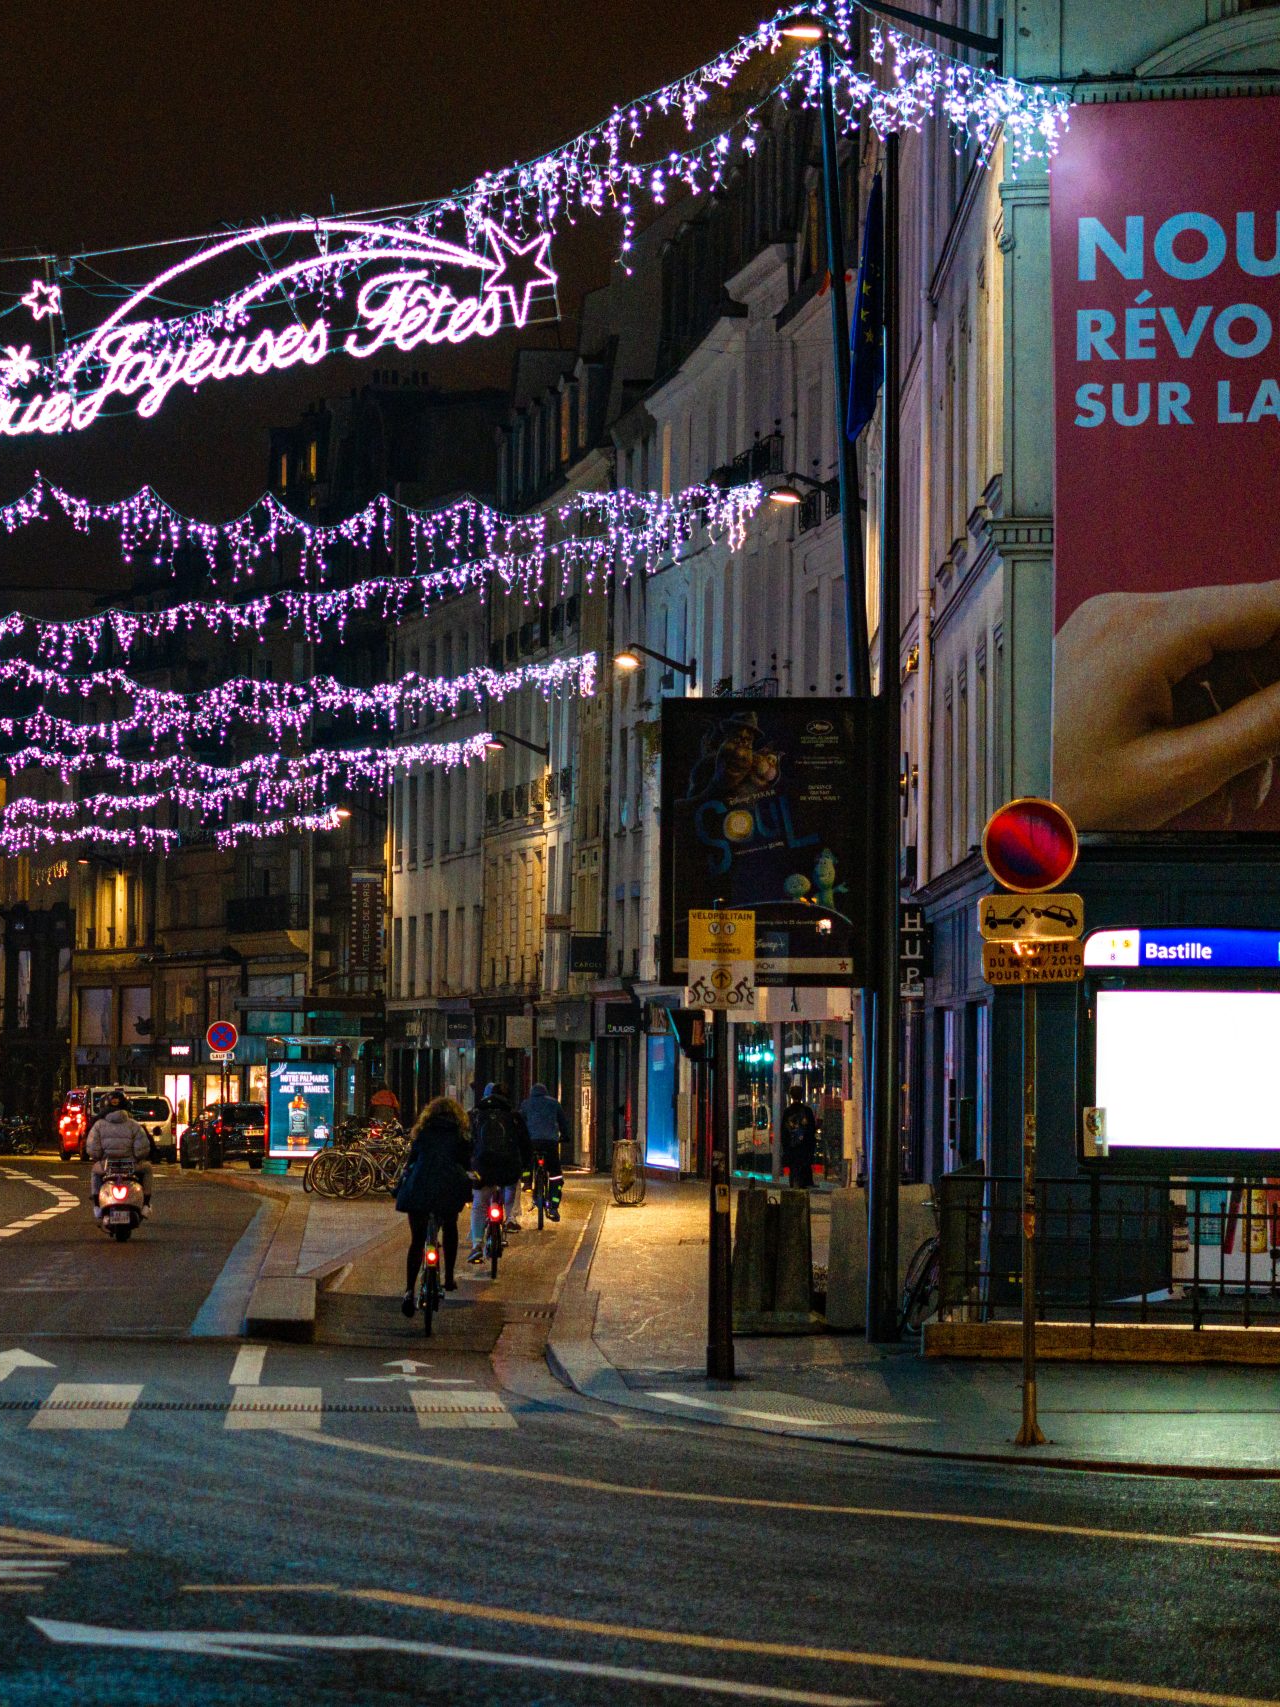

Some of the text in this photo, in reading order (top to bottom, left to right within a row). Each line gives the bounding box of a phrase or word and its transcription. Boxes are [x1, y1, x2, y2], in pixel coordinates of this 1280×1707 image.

[1075, 289, 1274, 361] RÉVO
[69, 269, 501, 430] Joyeuses Fêtes
[1073, 379, 1280, 428] SUR LA
[362, 883, 370, 962] ATELIERS DE PARIS
[990, 958, 1005, 968] DU
[1145, 943, 1213, 959] Bastille
[988, 968, 1080, 980] POUR TRAVAUX
[279, 1085, 295, 1093] JACK
